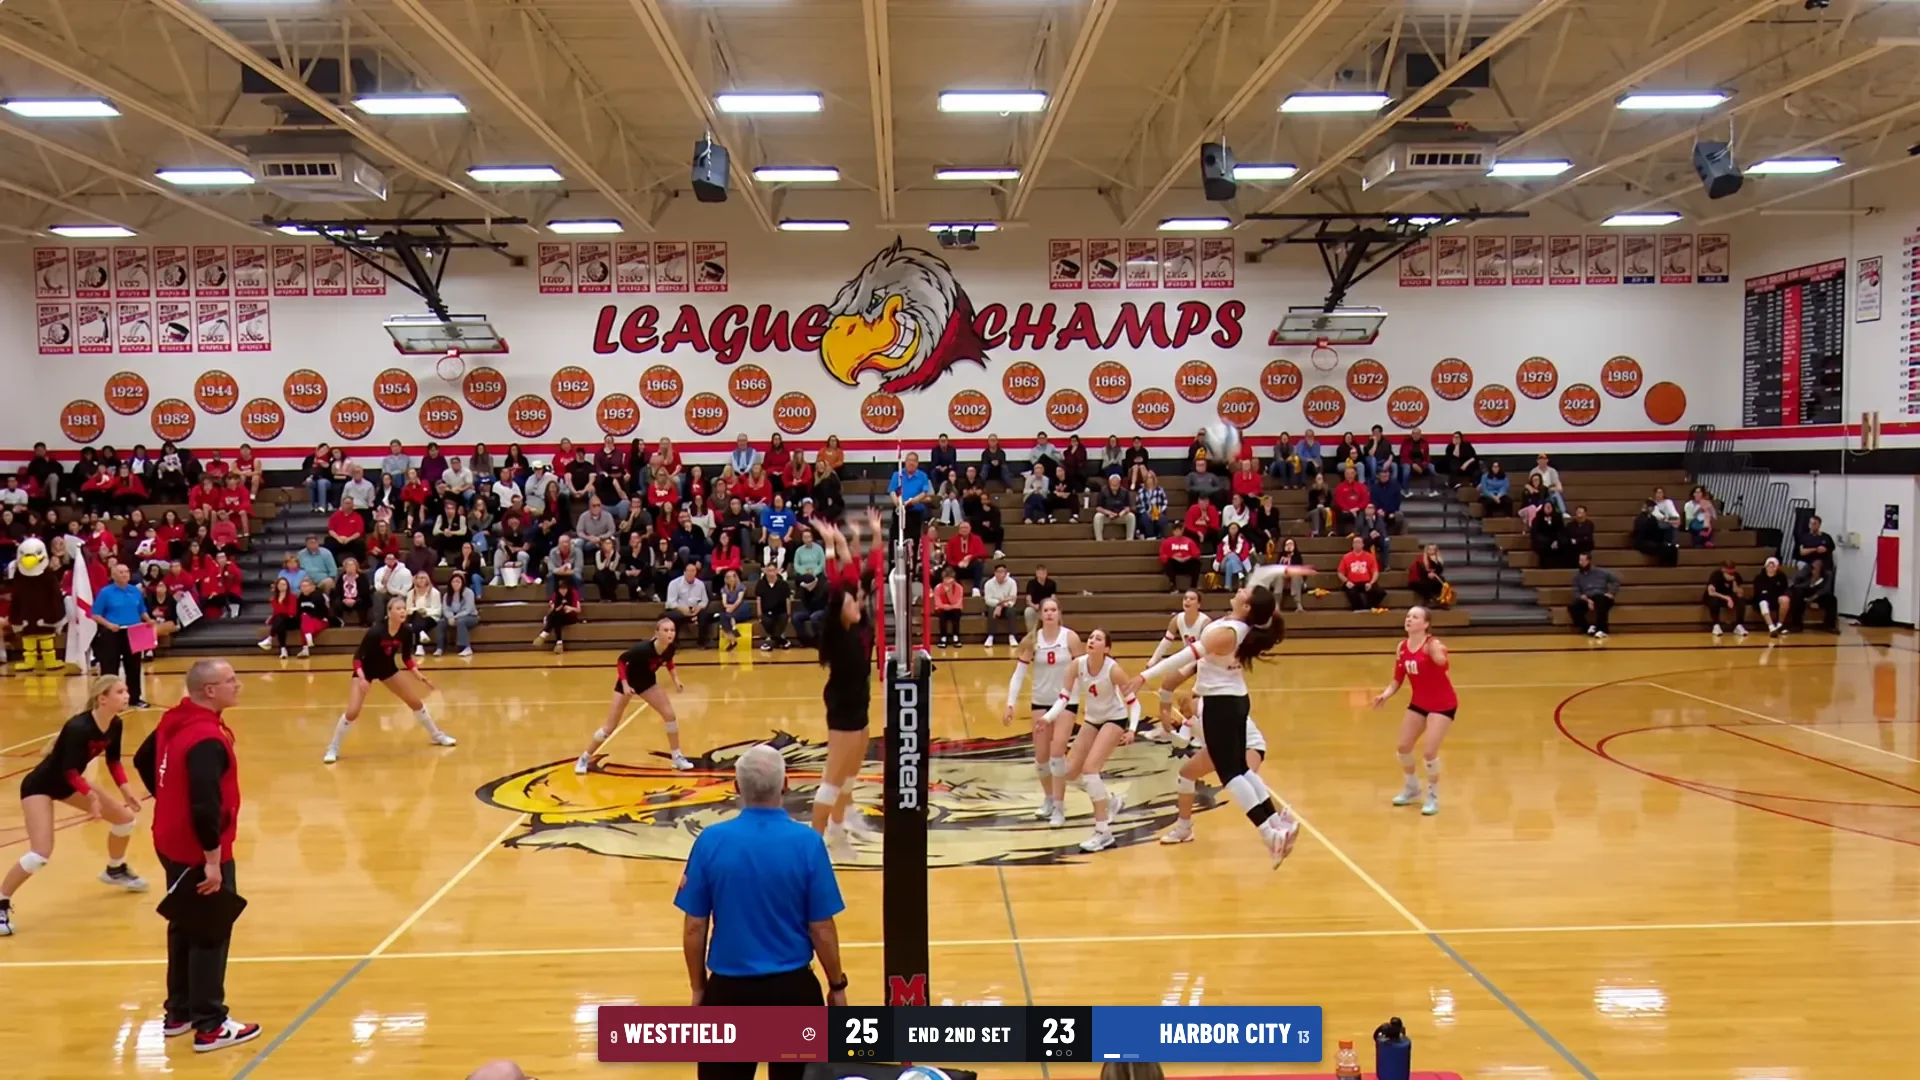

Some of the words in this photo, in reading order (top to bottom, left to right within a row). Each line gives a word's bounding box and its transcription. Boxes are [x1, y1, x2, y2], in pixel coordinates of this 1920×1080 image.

[593, 304, 829, 364] LEAGUE
[972, 300, 1246, 351] CHAMPS
[1182, 374, 1213, 386] 1969
[1267, 374, 1297, 385] 1970
[1353, 373, 1384, 385] 1972
[1438, 371, 1469, 384] 1978
[1523, 371, 1553, 383] 1979
[1608, 370, 1638, 382] 1980
[557, 380, 589, 392] 1962
[736, 378, 767, 390] 1966
[201, 385, 233, 397] 1944
[953, 404, 987, 416] 2002
[1051, 403, 1084, 415] 2004
[1137, 402, 1170, 414] 2006
[1222, 401, 1255, 414] 2007
[1391, 400, 1424, 412] 2020
[1479, 398, 1509, 410] 2021
[1564, 398, 1595, 410] 2021
[337, 411, 369, 423] 1990
[516, 409, 547, 421] 1996
[692, 407, 723, 418] 1999
[778, 406, 811, 417] 2000
[866, 405, 897, 417] 2001
[67, 414, 98, 426] 1981
[158, 413, 190, 425] 1982
[247, 412, 280, 424] 1989
[1047, 651, 1056, 665] 8
[1088, 684, 1098, 697] 4
[888, 973, 927, 1006] M
